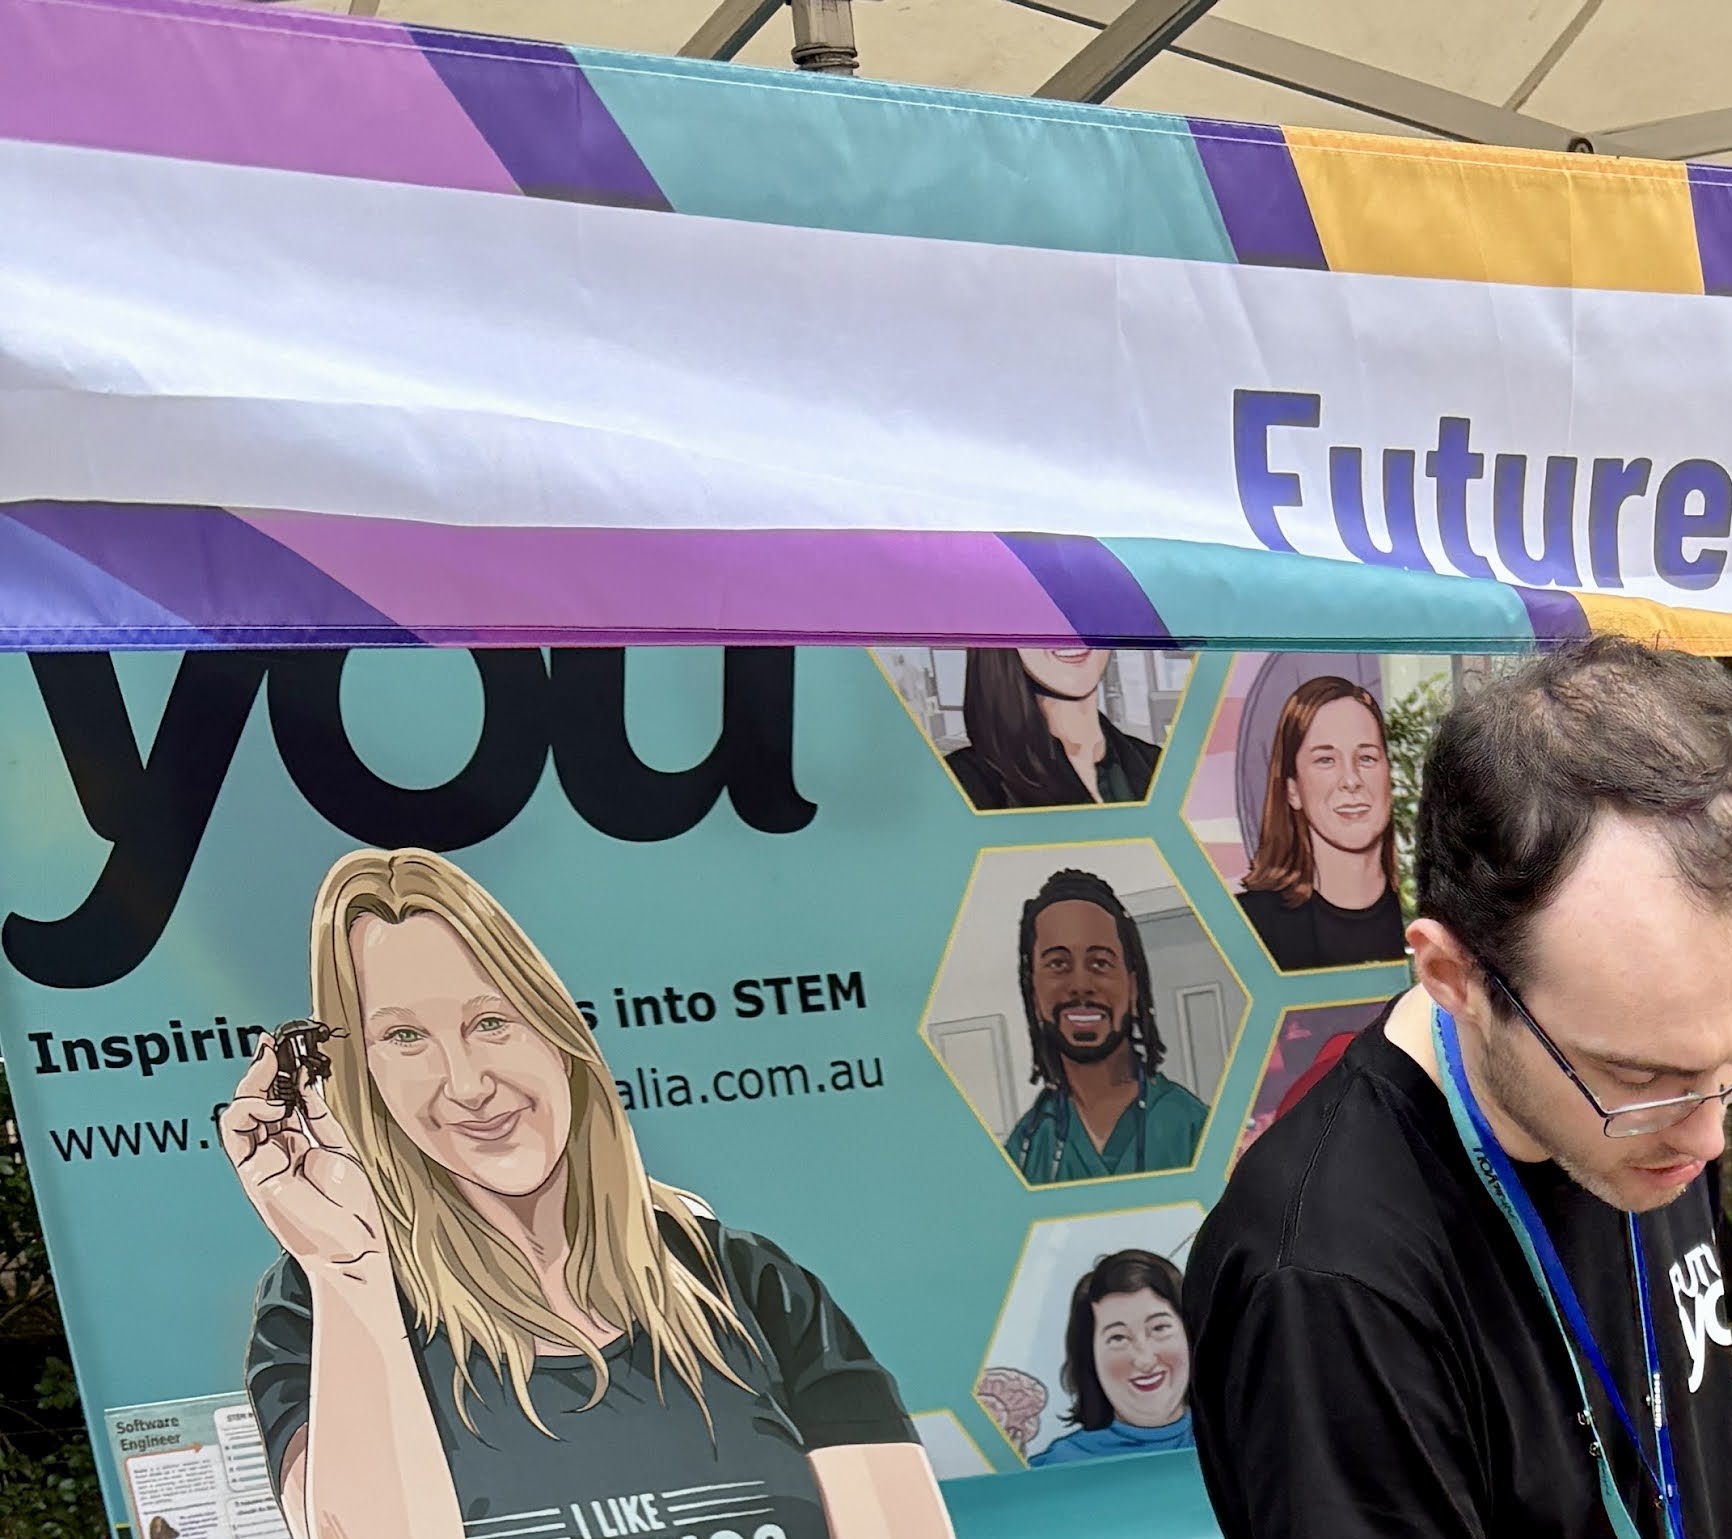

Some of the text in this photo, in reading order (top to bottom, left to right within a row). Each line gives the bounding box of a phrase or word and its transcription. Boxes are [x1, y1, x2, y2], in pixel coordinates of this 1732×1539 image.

[0, 648, 818, 990] you
[28, 1016, 268, 1077] Inspirin
[614, 987, 716, 1028] into
[733, 971, 867, 1018] STEM
[1679, 1279, 1732, 1393] yo
[116, 1416, 179, 1434] Software
[120, 1433, 181, 1452] Engineer
[571, 1493, 668, 1539] I LIKE
